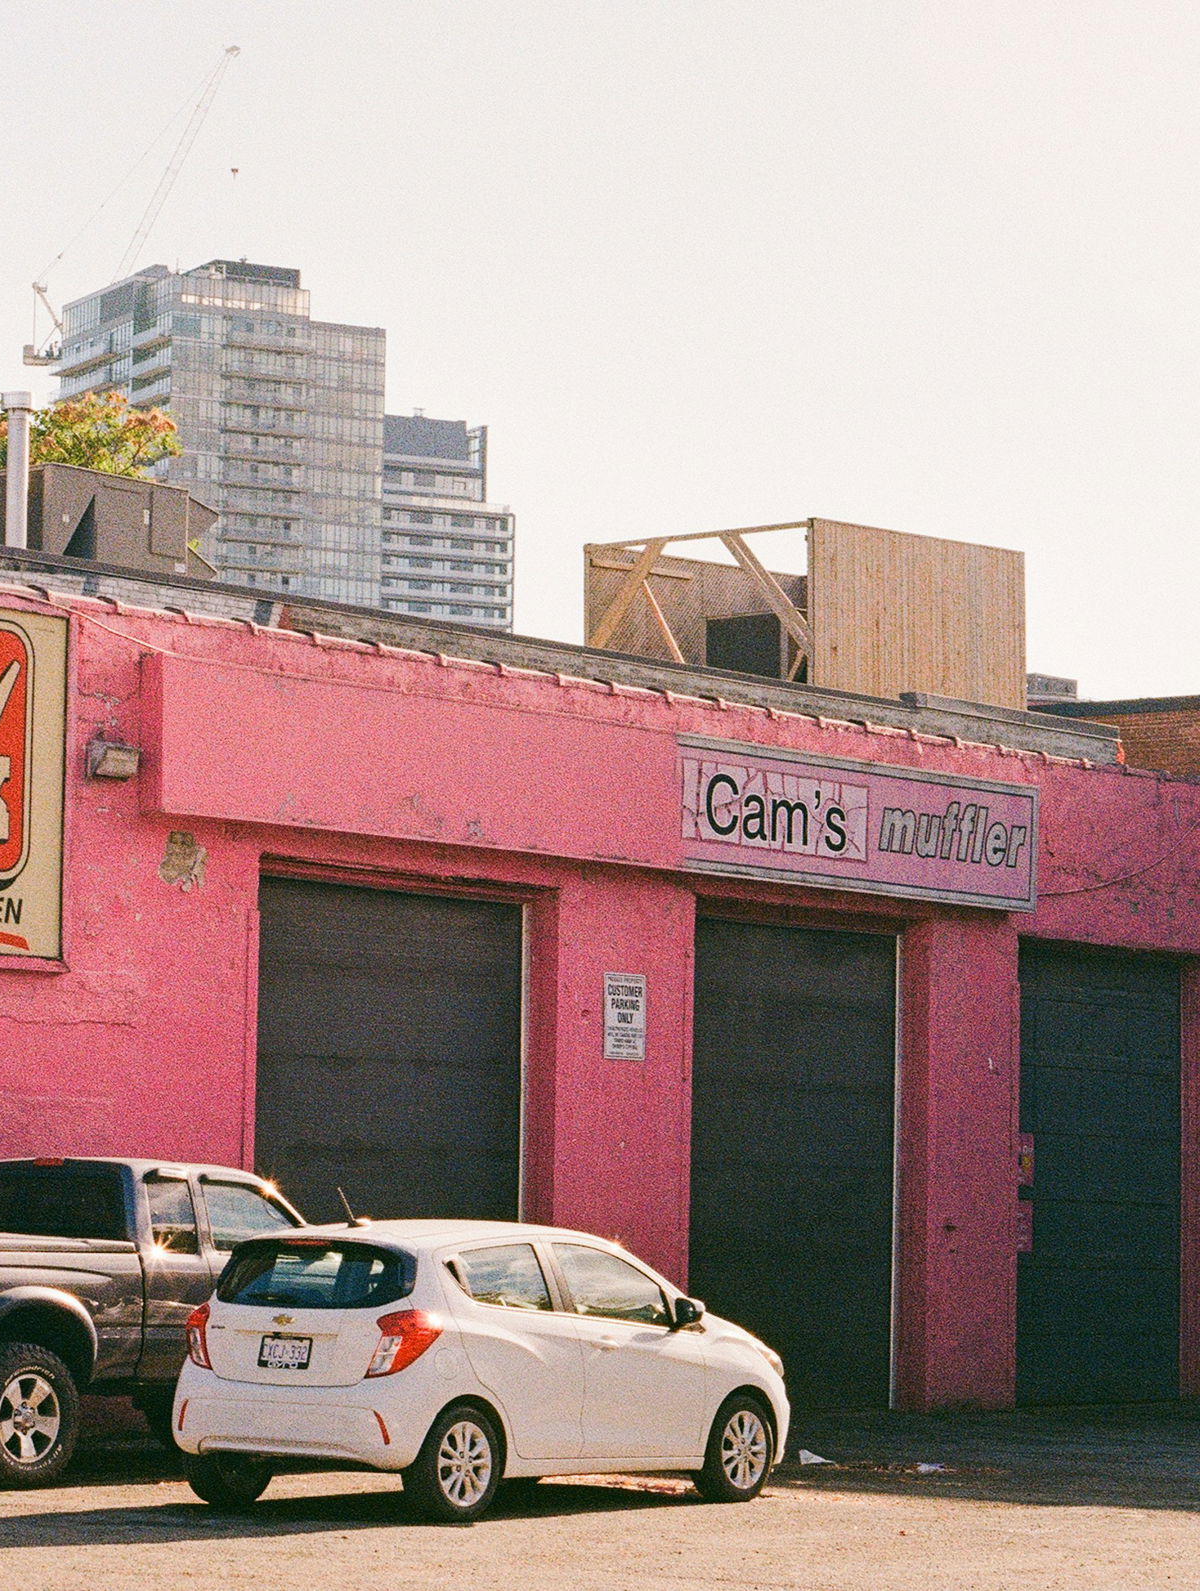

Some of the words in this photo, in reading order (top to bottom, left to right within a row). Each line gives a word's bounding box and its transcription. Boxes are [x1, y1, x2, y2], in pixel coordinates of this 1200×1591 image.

[704, 771, 849, 852] Cam's
[878, 800, 1027, 868] muffler
[607, 984, 643, 997] CUSTOMER
[611, 998, 640, 1011] PARKING
[617, 1012, 634, 1024] ONLY
